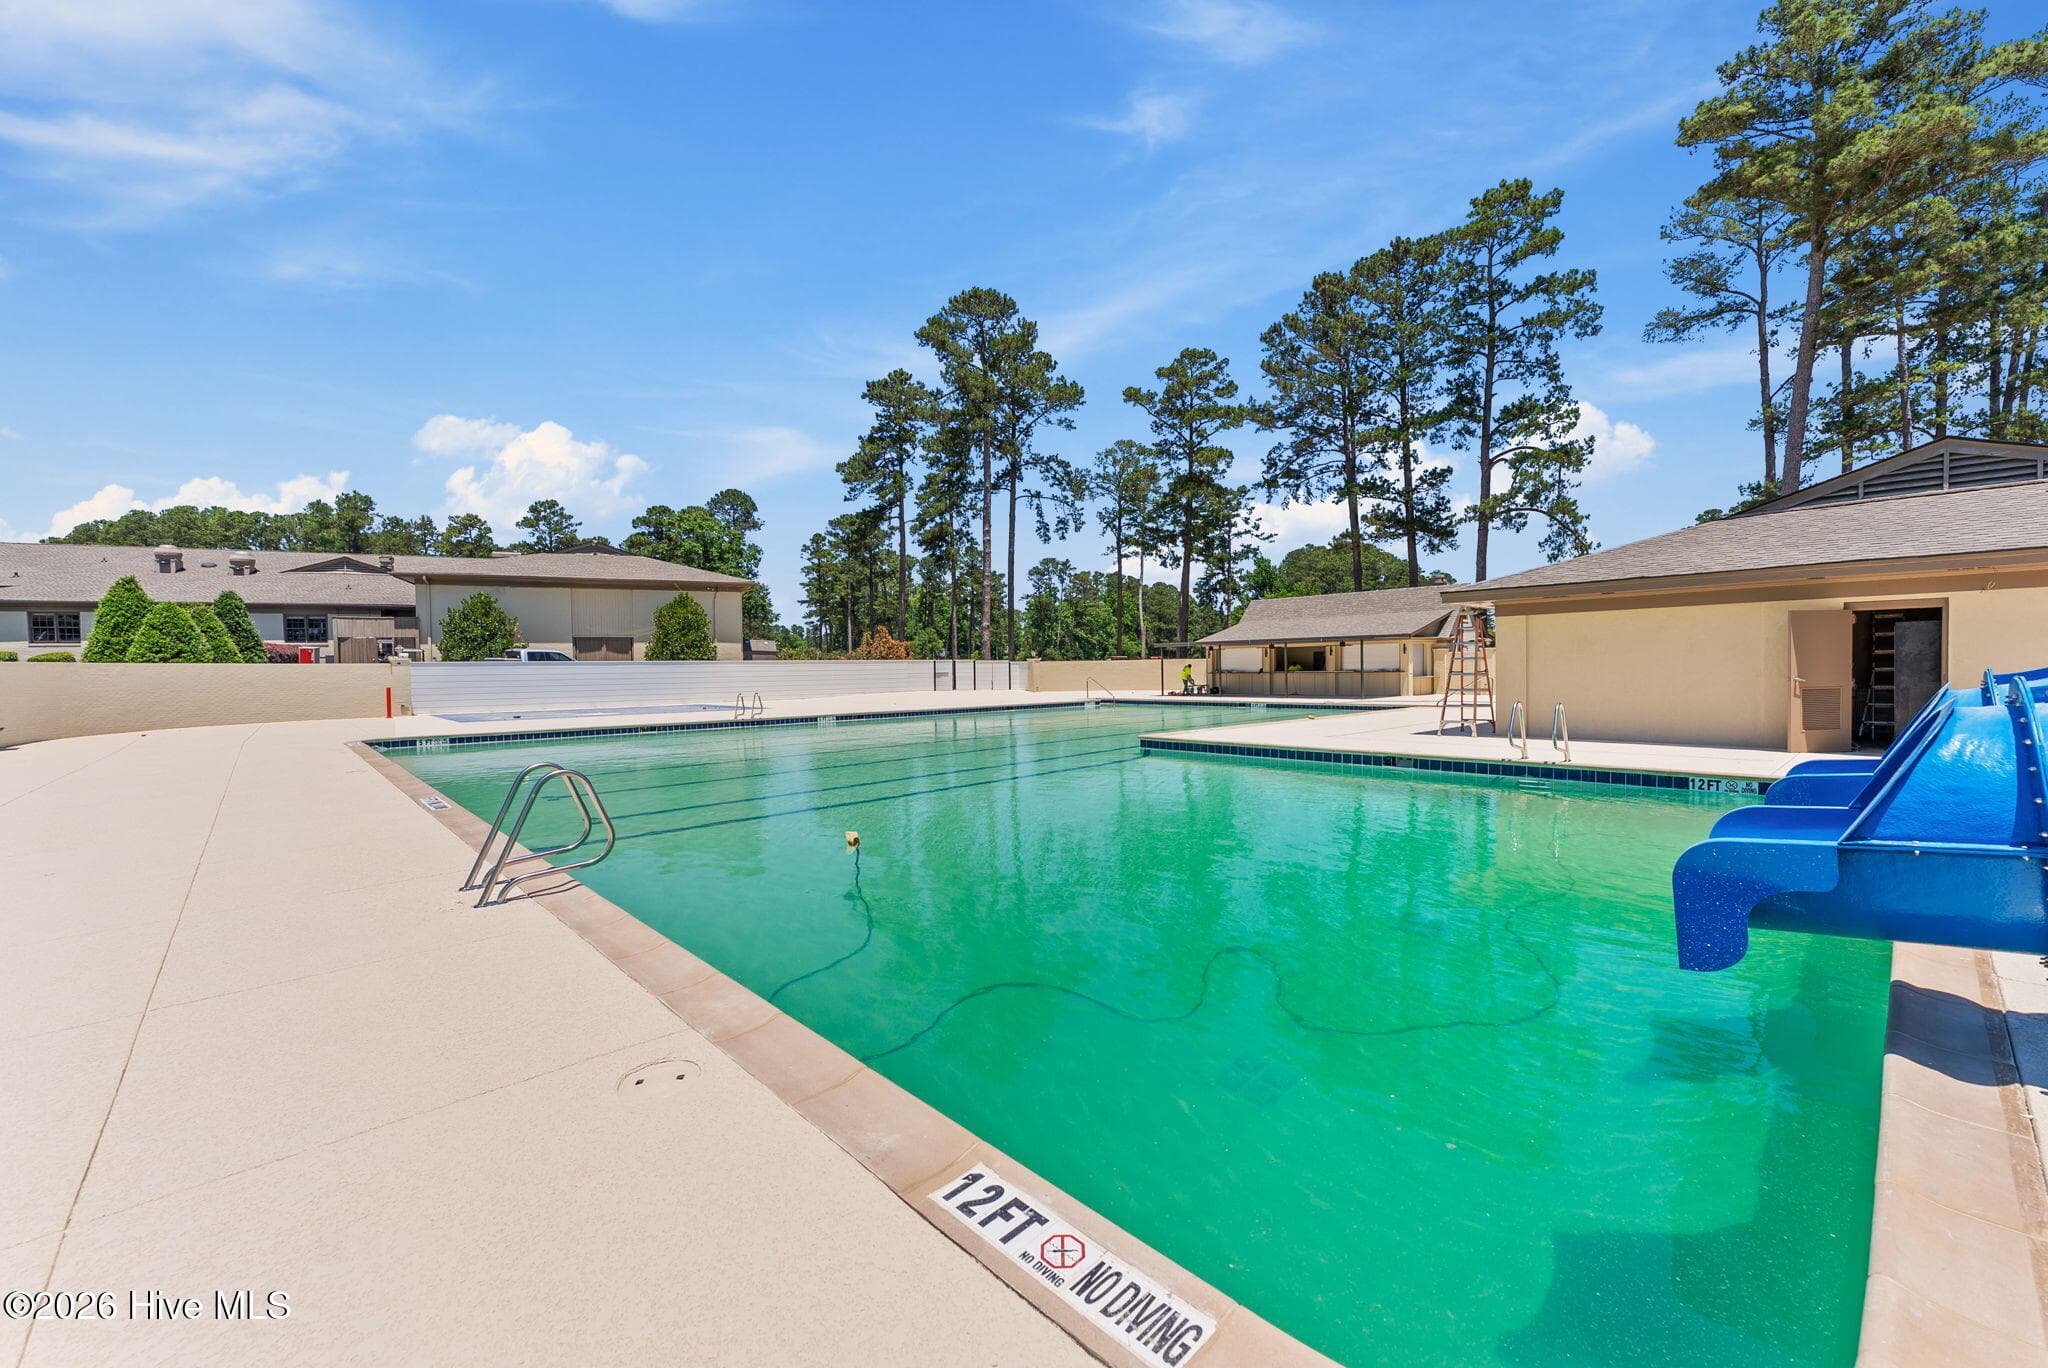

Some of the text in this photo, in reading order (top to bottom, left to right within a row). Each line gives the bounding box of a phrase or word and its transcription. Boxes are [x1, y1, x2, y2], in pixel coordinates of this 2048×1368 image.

[1690, 778, 1721, 792] 12FT
[942, 1173, 1050, 1245] 12FT
[1019, 1250, 1065, 1288] NO DIVING
[1069, 1261, 1203, 1367] NO DIVING
